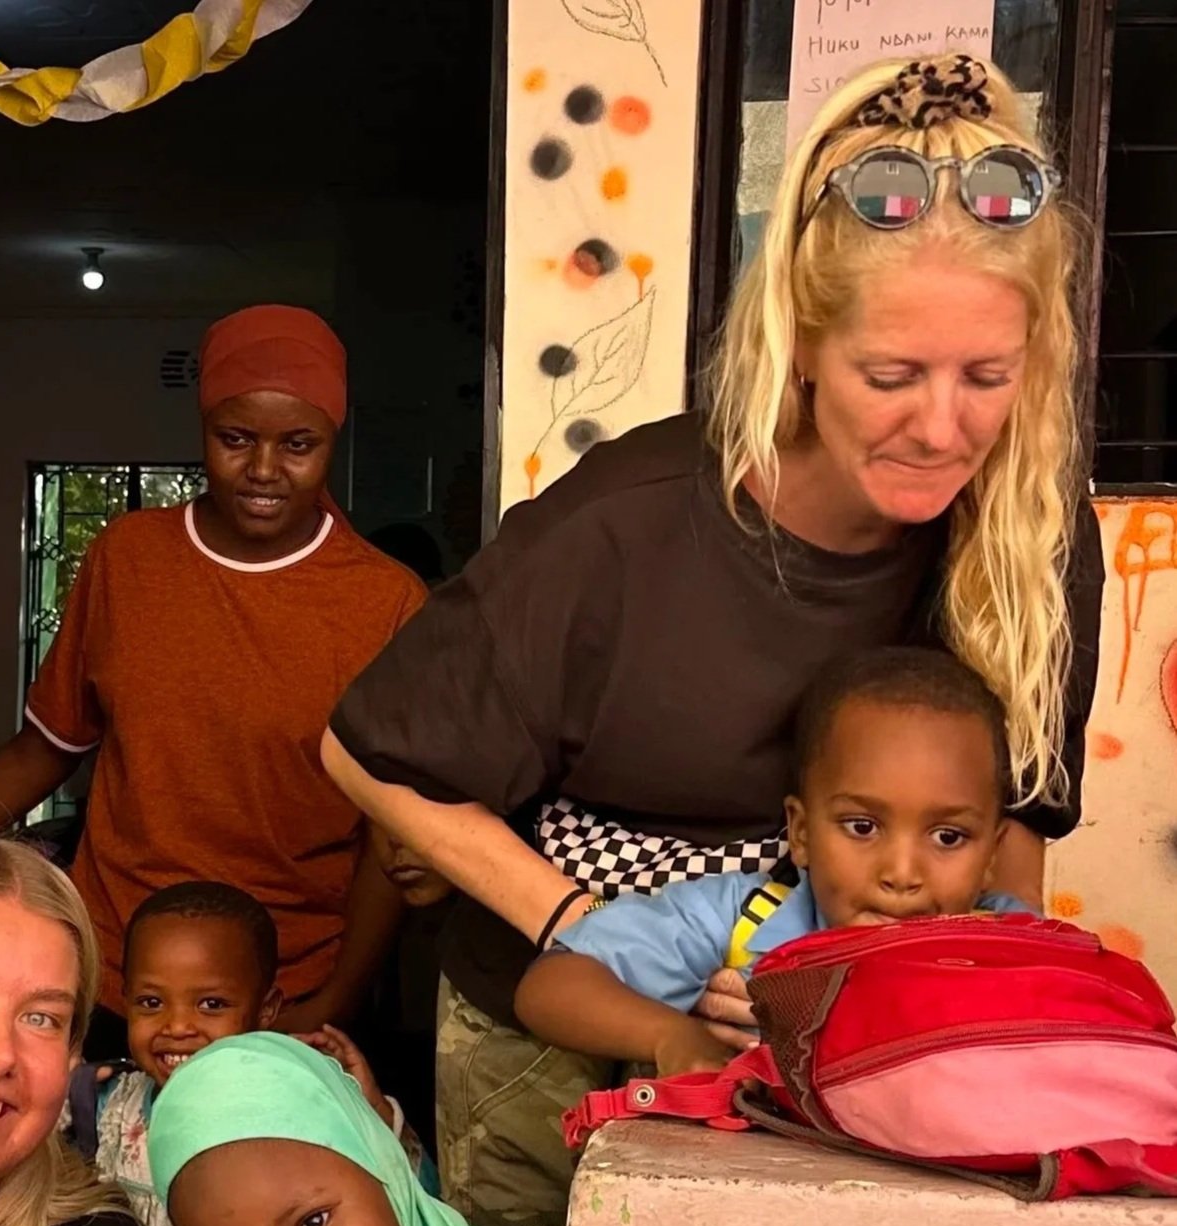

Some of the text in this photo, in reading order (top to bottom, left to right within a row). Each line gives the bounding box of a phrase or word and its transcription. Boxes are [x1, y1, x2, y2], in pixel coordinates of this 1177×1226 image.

[808, 25, 989, 58] HUKU NDANI KAMA
